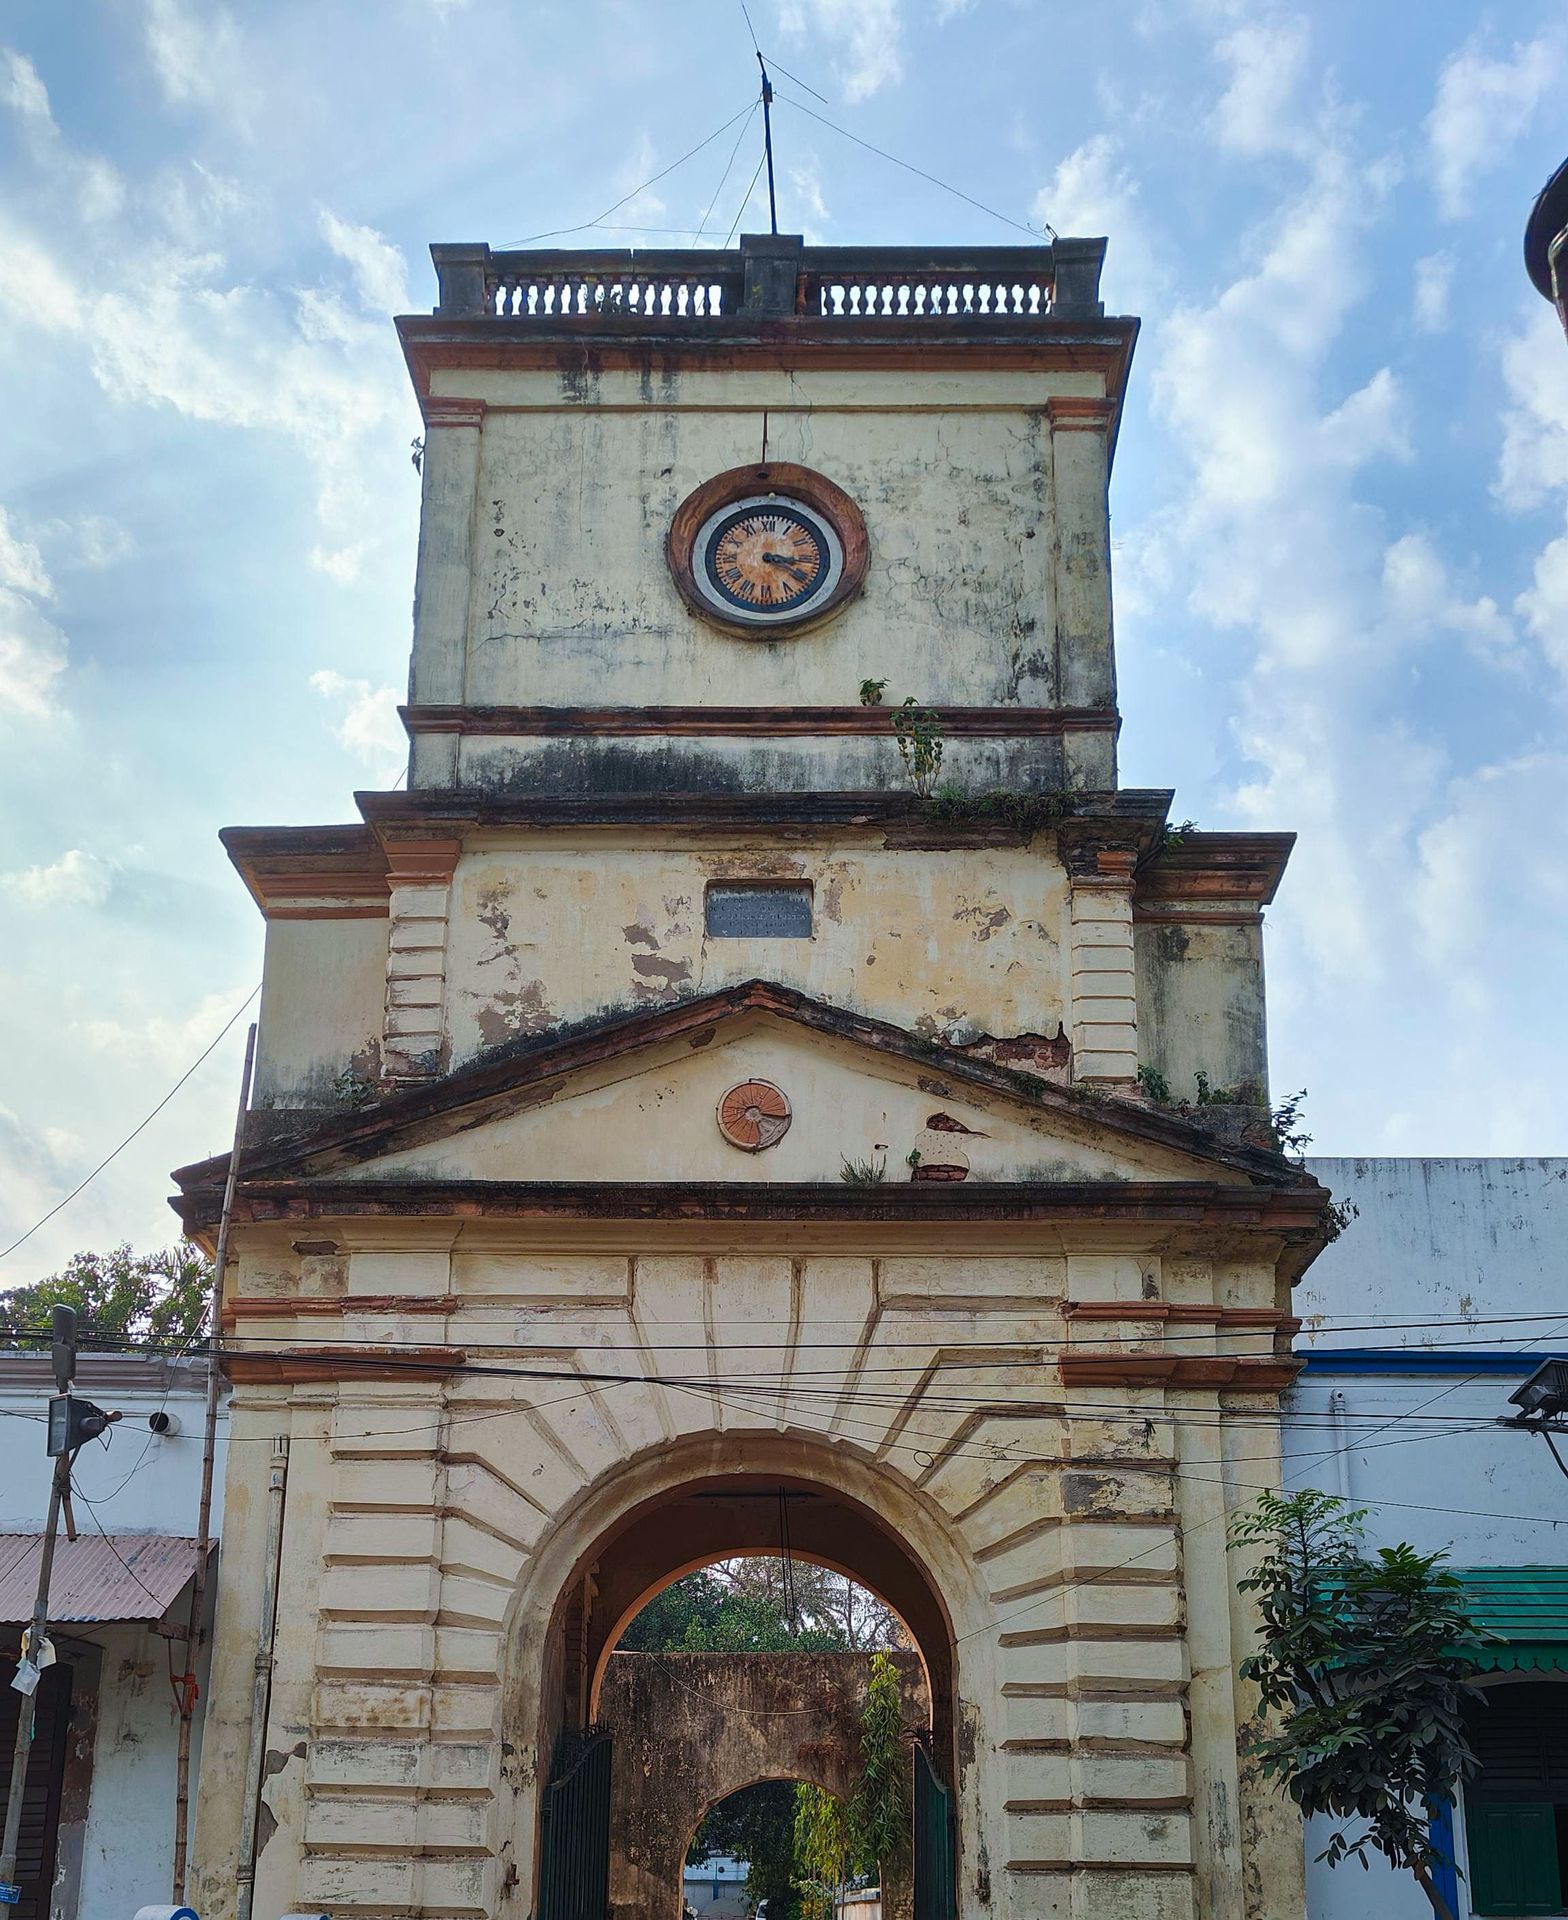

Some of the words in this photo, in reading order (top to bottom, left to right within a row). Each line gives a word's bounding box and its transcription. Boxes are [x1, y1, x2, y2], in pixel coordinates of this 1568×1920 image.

[742, 524, 756, 538] XI
[761, 520, 775, 532] XII
[783, 525, 791, 535] I
[728, 536, 742, 548] X
[793, 538, 808, 546] II
[761, 585, 771, 598] VI
[783, 581, 793, 594] V
